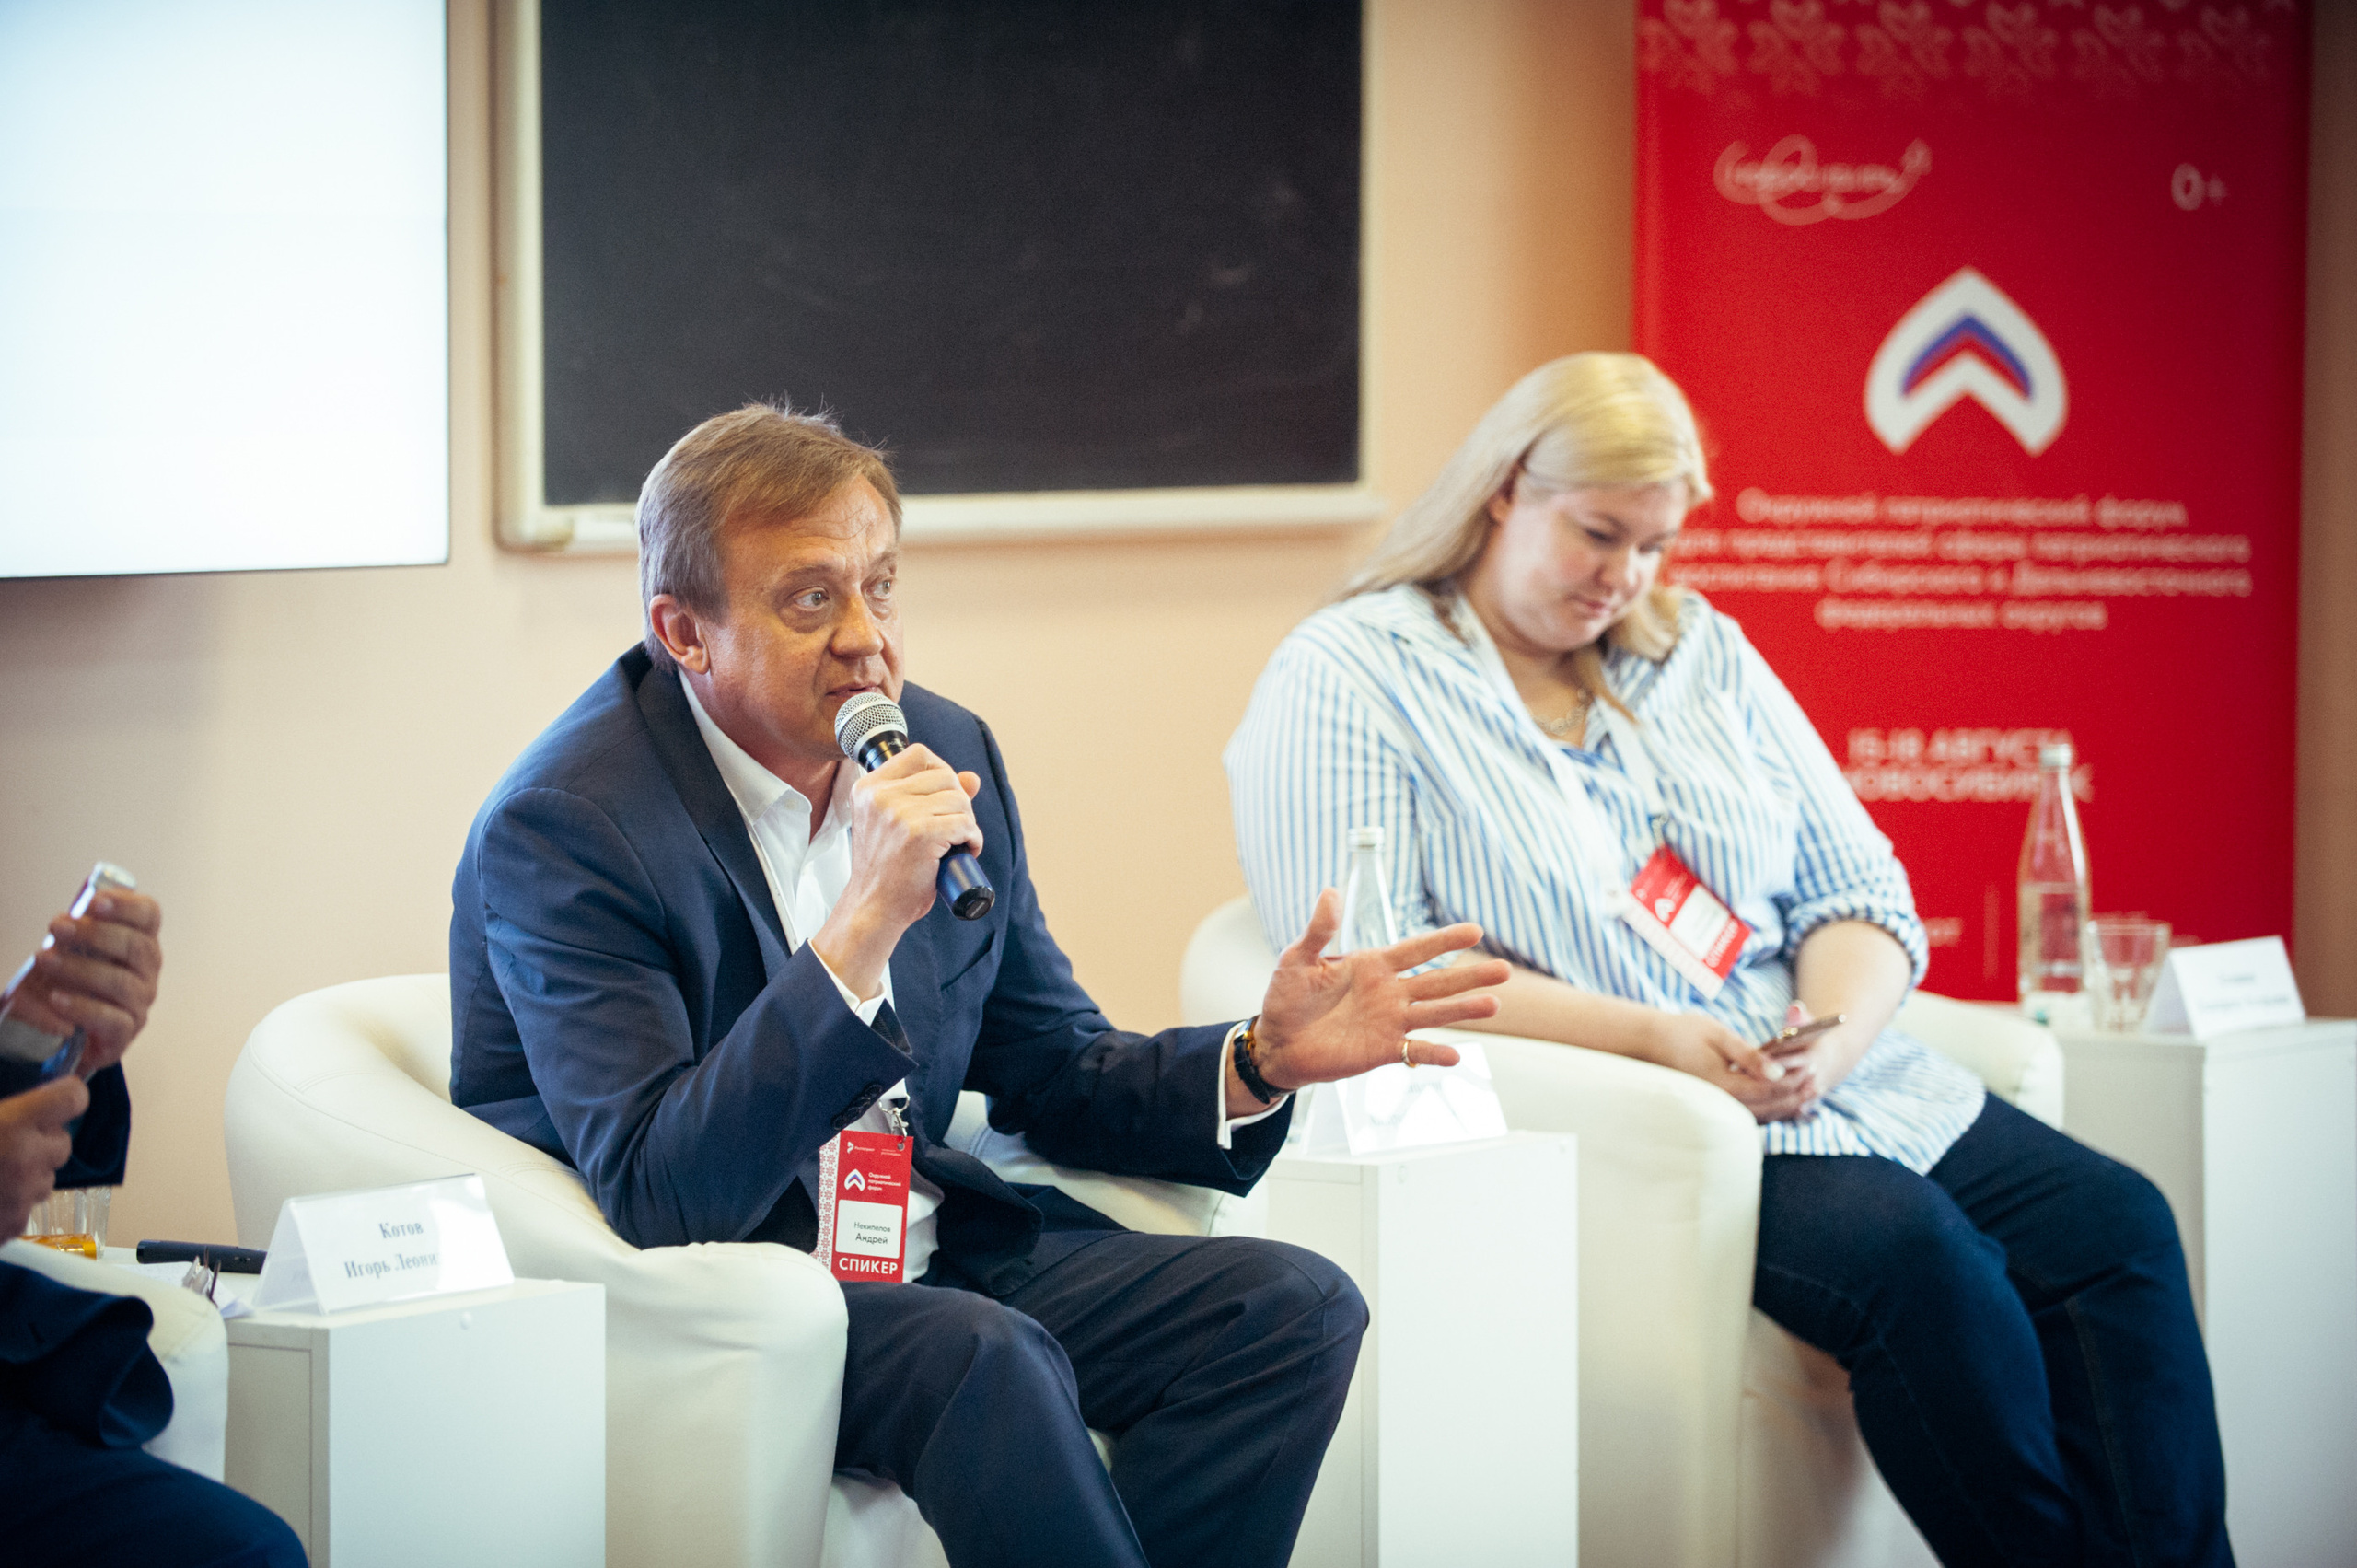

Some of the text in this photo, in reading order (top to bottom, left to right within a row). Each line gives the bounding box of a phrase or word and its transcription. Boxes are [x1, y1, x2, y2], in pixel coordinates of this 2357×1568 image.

[2171, 163, 2227, 211] 0+
[1929, 729, 2073, 764] АВГУСТ
[378, 1222, 424, 1239] Котов
[853, 1221, 891, 1233] Некипелов
[855, 1233, 888, 1245] Андрей
[344, 1253, 439, 1279] Игорь Леони
[839, 1257, 899, 1275] СПИКЕР
